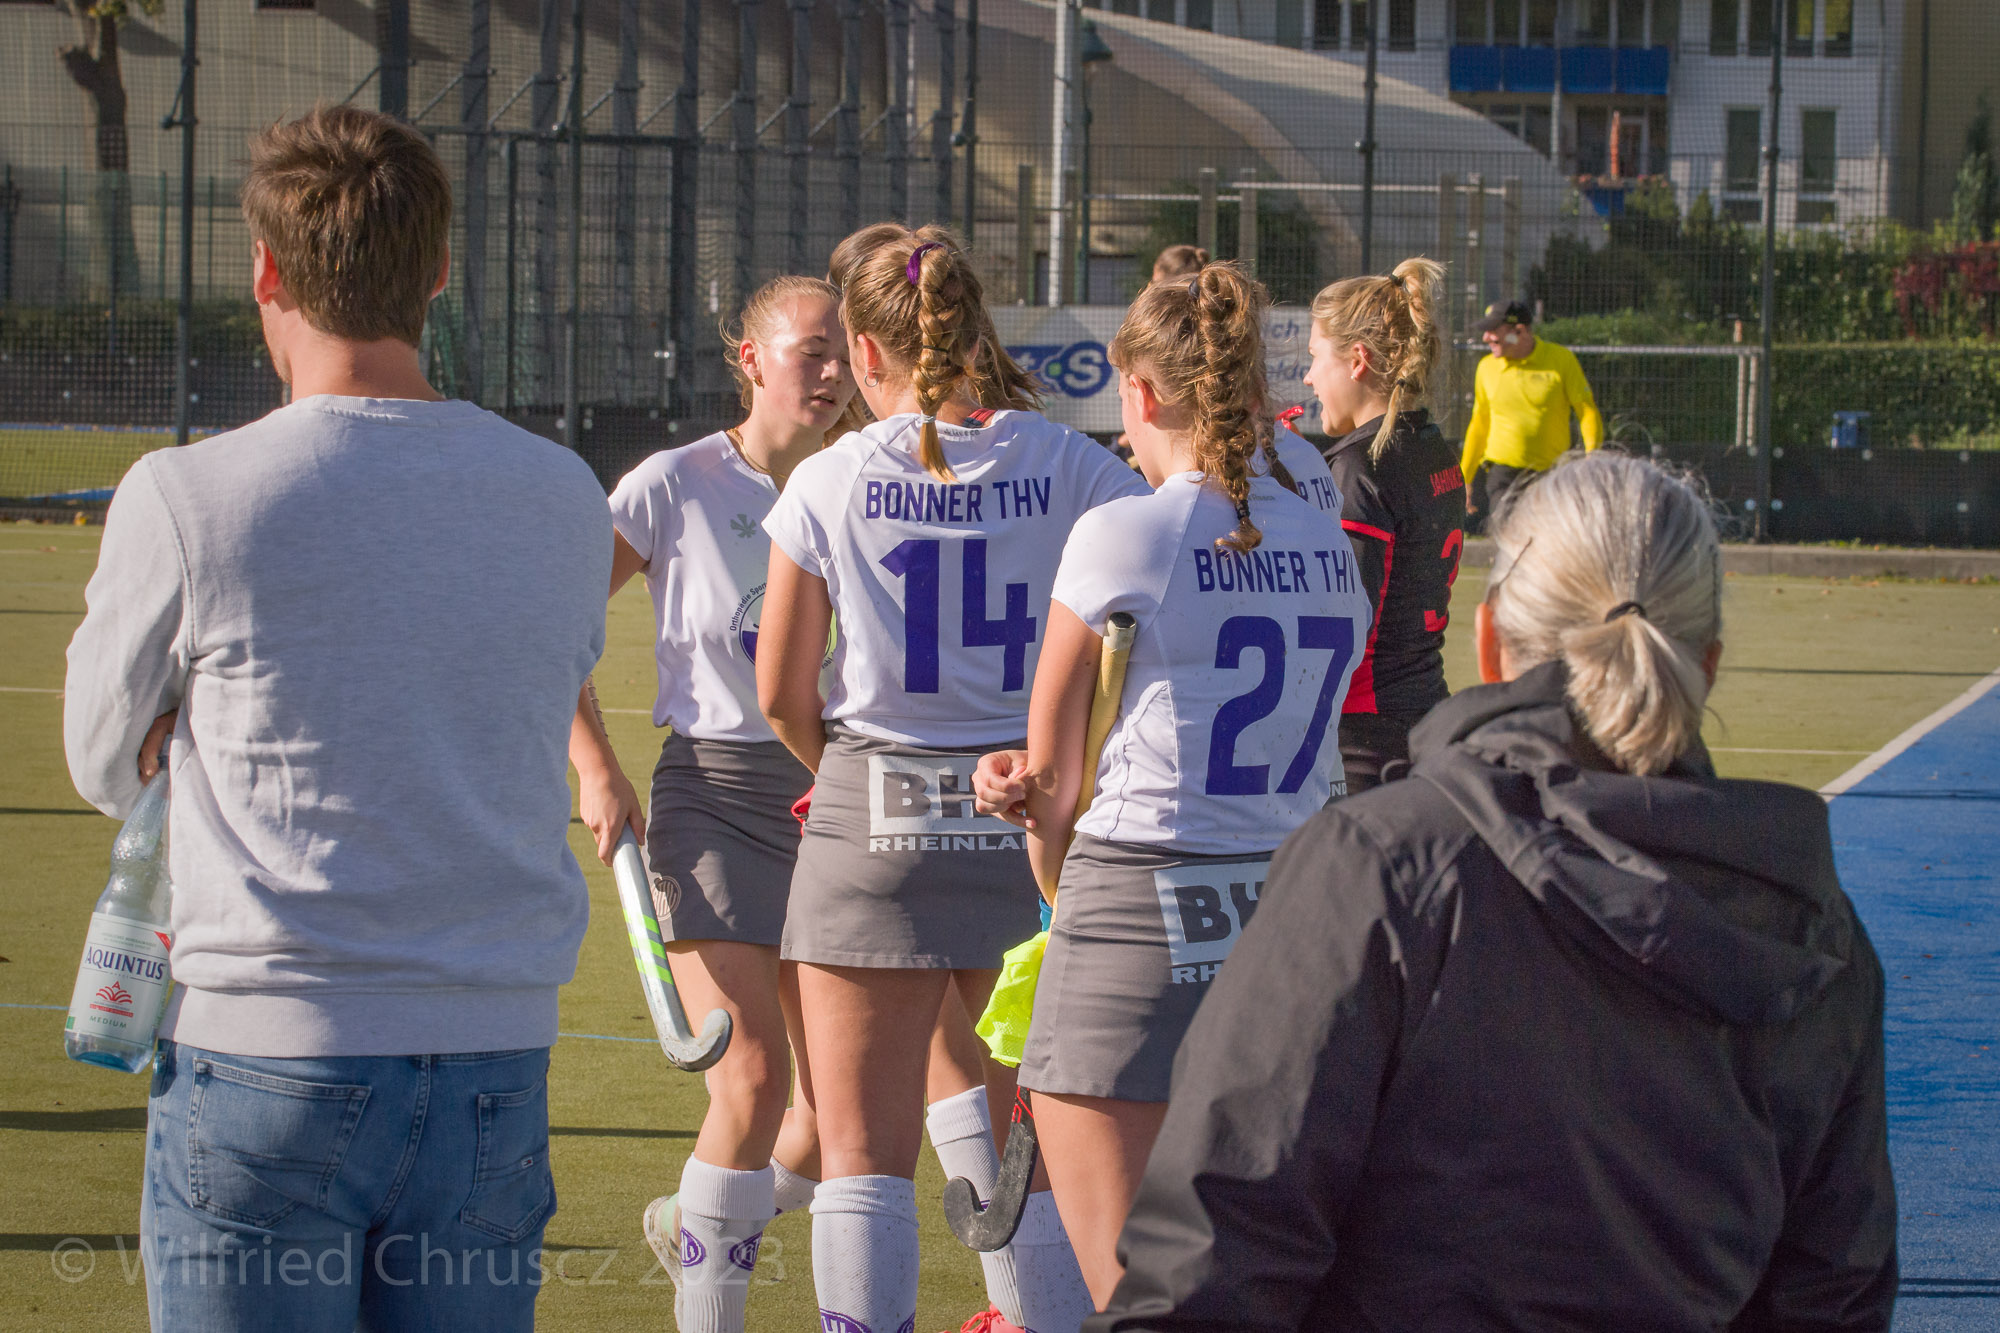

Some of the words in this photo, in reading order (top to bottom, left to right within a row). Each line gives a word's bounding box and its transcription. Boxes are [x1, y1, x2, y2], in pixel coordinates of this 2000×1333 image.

[865, 480, 982, 523] BONNER
[993, 476, 1051, 518] THV
[1194, 548, 1310, 594] BONNER
[1314, 550, 1356, 595] THV
[729, 593, 752, 632] Orthopädie
[878, 538, 1036, 694] 14
[1204, 615, 1354, 796] 27
[882, 770, 986, 818] BH
[869, 835, 1027, 853] RHEINLA
[85, 946, 165, 980] AQUINTUS
[89, 1015, 127, 1029] MEDIUM
